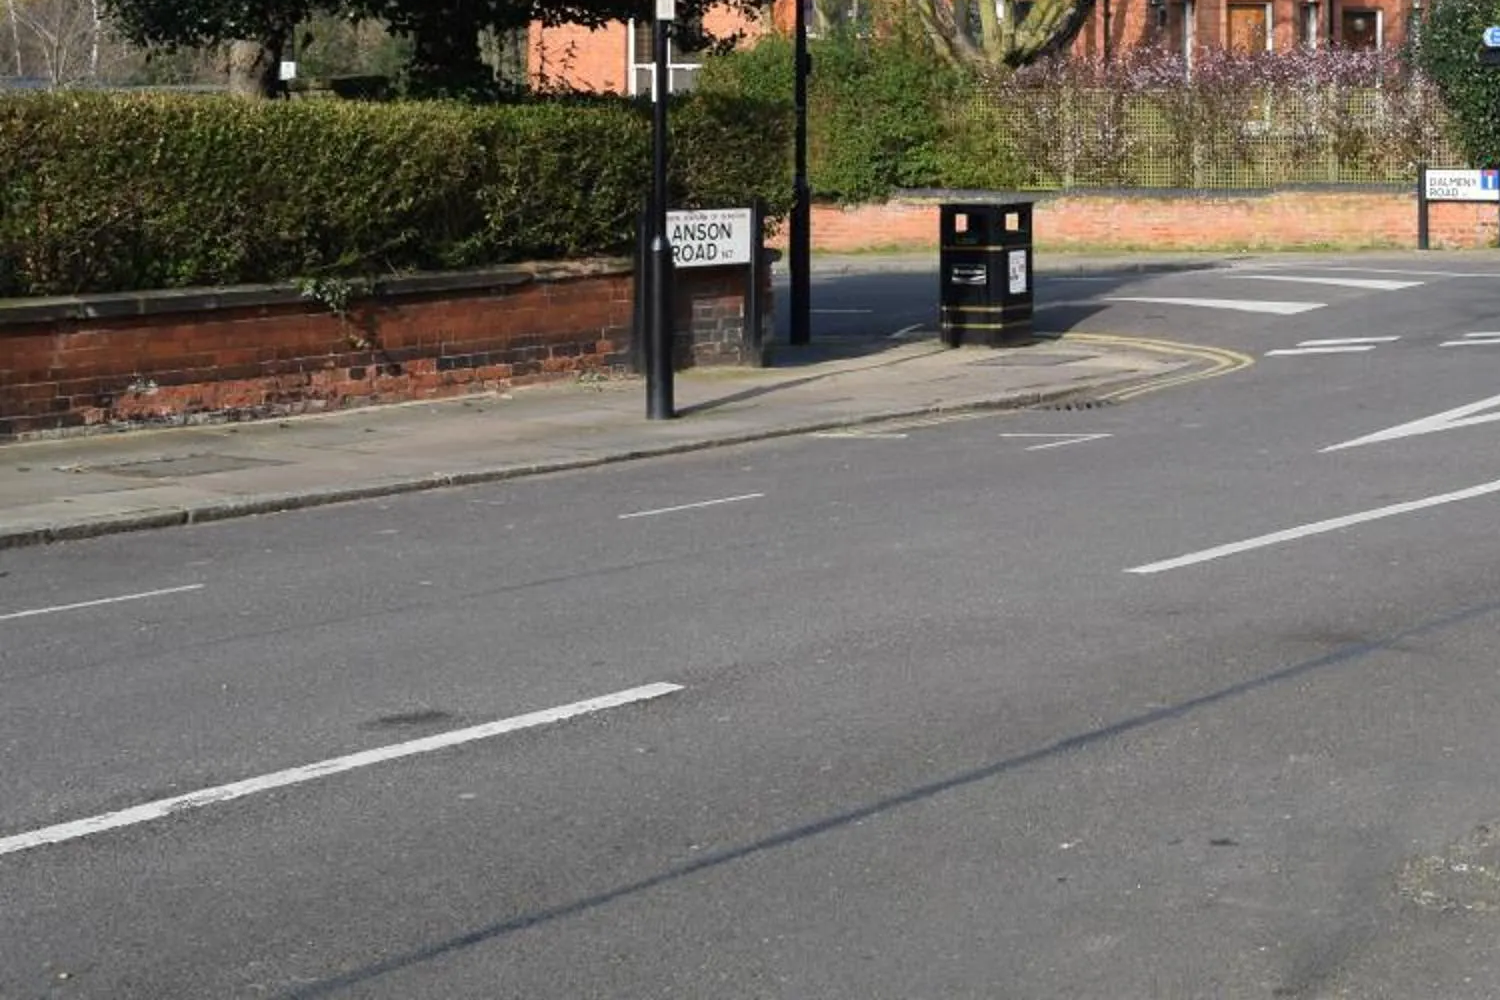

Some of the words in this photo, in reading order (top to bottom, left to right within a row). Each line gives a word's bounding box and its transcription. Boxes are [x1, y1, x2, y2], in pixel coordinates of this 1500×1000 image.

[1429, 177, 1477, 187] DALMENY
[1429, 187, 1459, 197] ROAD
[672, 222, 733, 242] ANSON
[671, 243, 717, 262] ROAD
